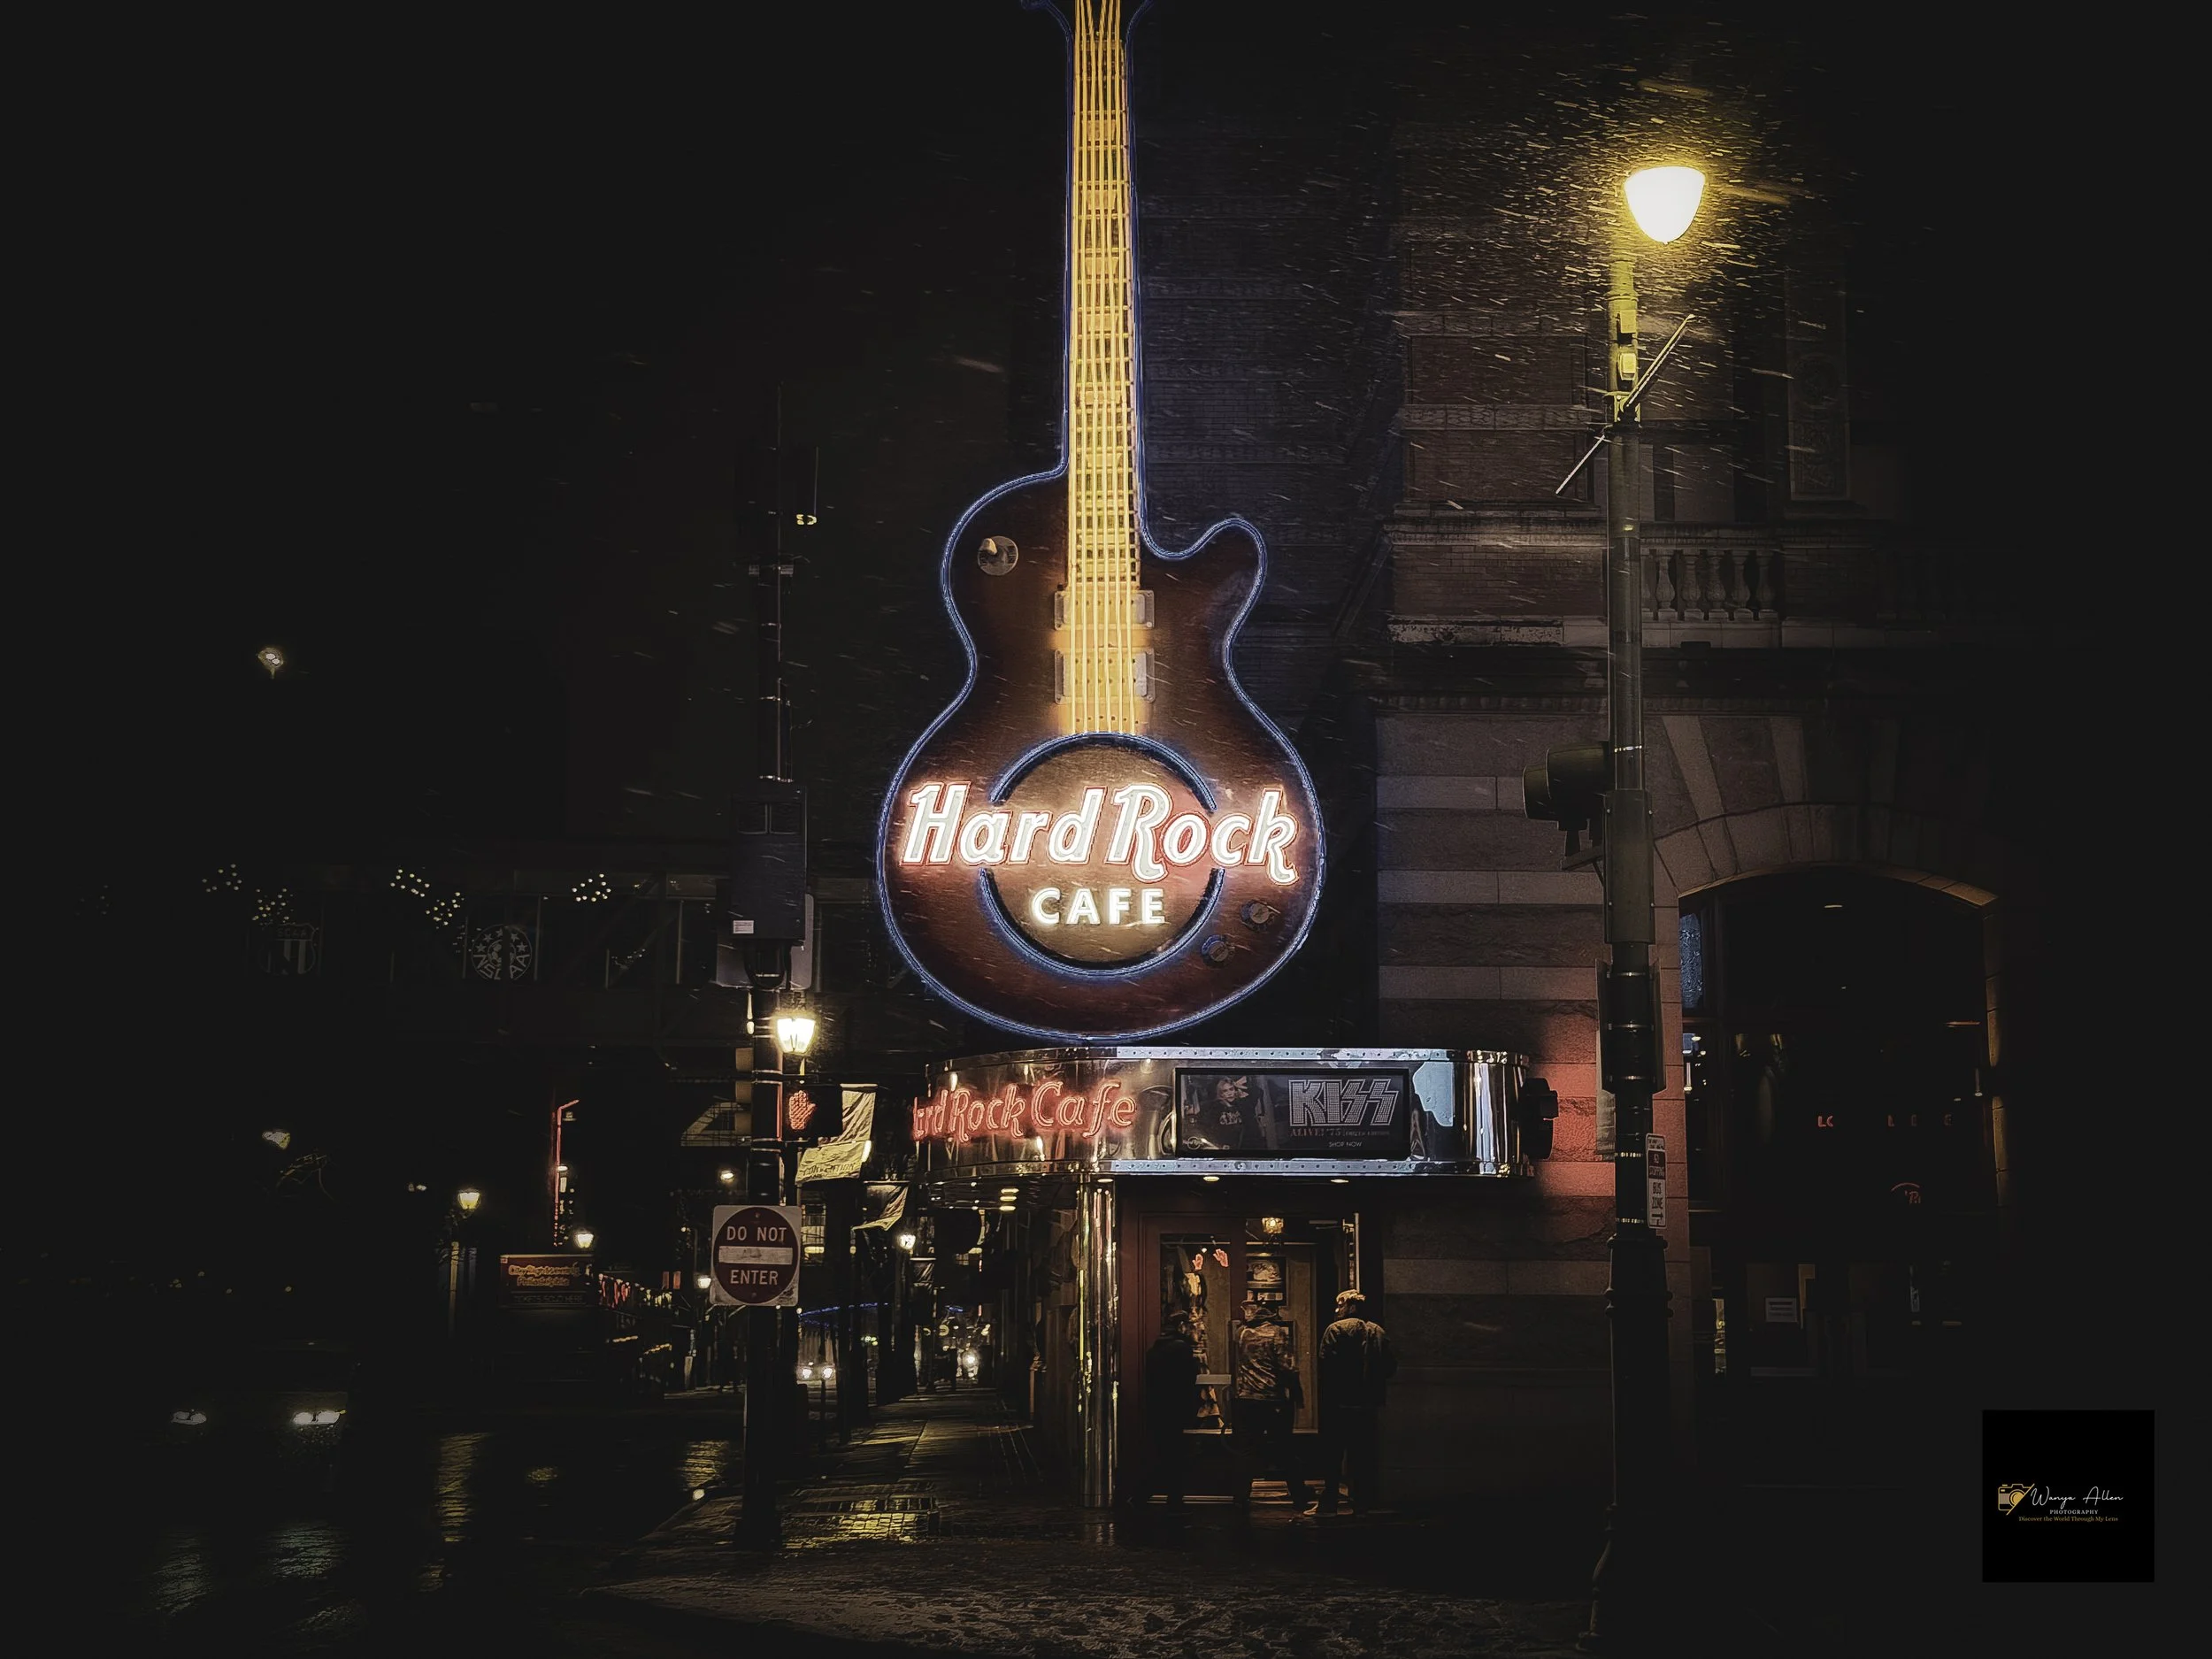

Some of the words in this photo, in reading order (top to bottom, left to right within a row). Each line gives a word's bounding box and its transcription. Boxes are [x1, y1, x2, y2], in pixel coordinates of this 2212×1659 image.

[900, 781, 1108, 867] Hard
[1104, 782, 1300, 886] Rock
[1029, 887, 1166, 926] CAFE
[948, 1082, 1026, 1143] Rock
[1031, 1078, 1138, 1139] Cafe
[1288, 1079, 1400, 1127] KISS
[726, 1226, 747, 1241] DO
[757, 1227, 787, 1241] NOT
[730, 1270, 779, 1286] ENTER
